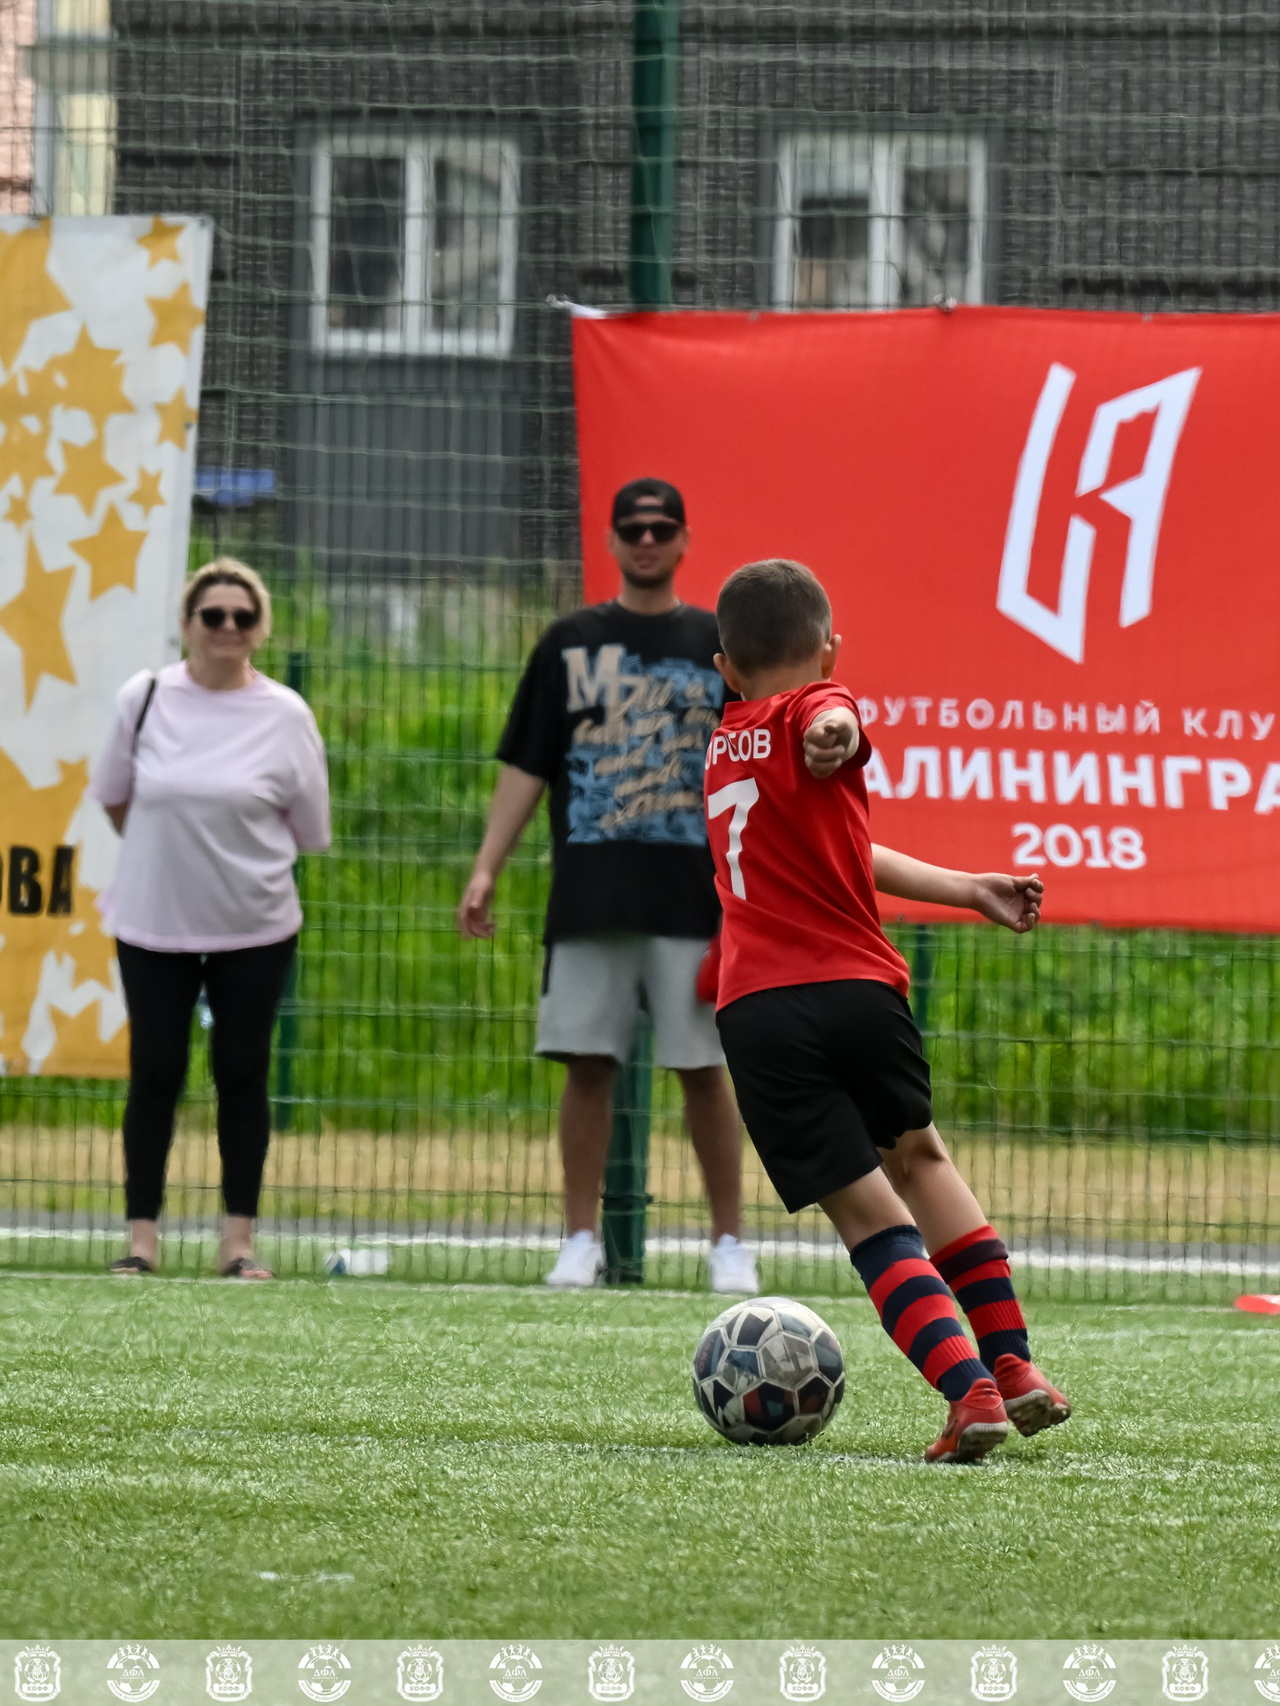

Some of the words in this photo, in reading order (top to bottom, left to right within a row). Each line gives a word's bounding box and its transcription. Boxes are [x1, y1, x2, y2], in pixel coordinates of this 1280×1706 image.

[855, 696, 1161, 736] ФУТБОЛЬНЫЙ
[707, 777, 760, 900] 7
[1012, 823, 1147, 870] 2018
[0, 845, 75, 917] ВА
